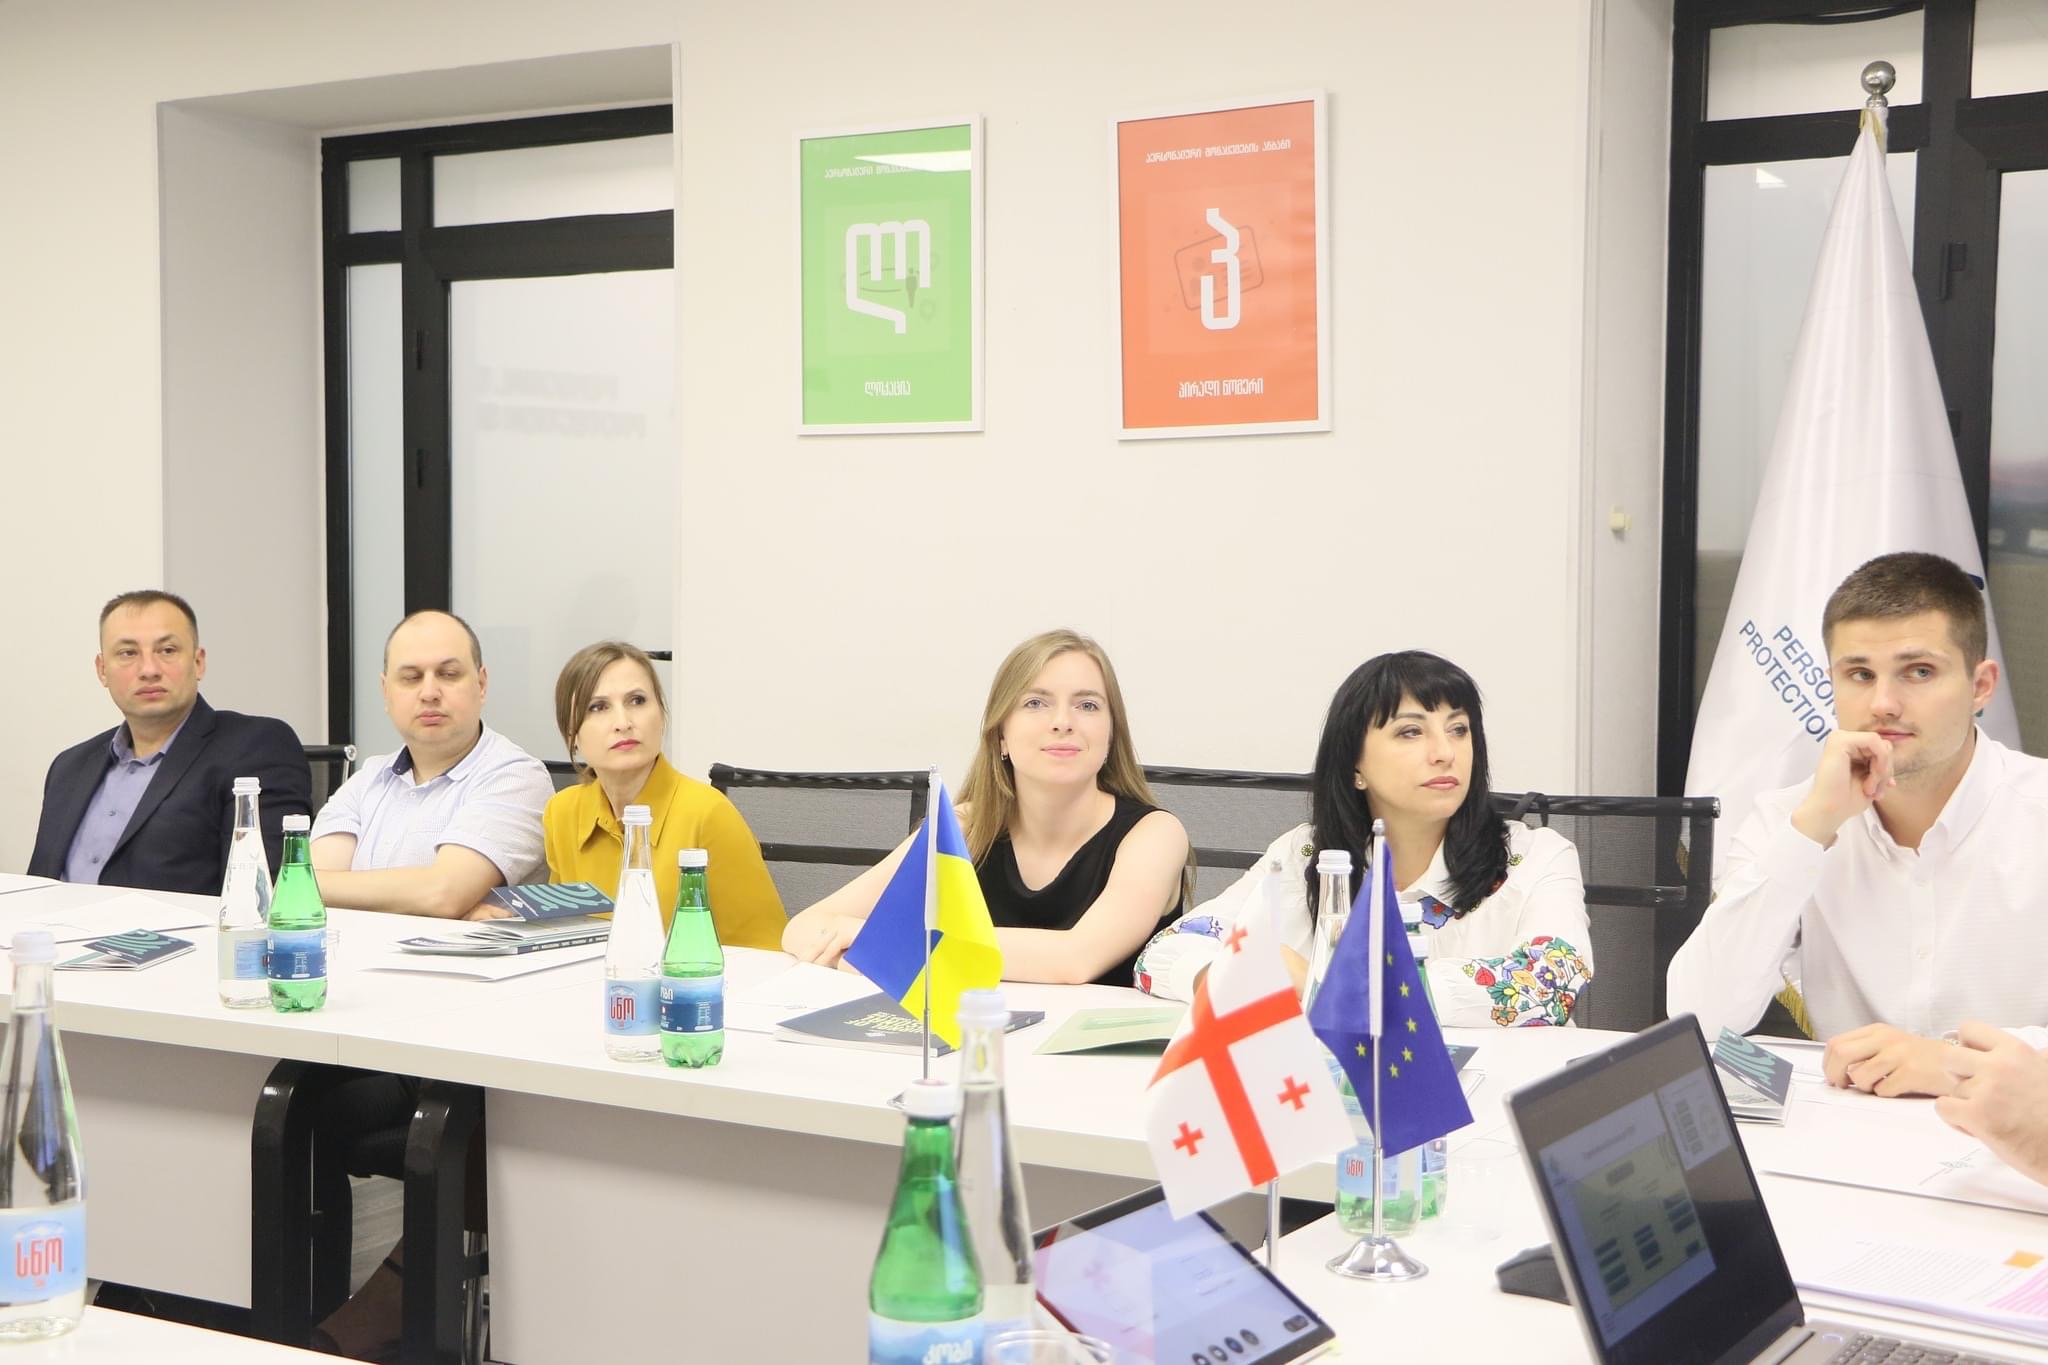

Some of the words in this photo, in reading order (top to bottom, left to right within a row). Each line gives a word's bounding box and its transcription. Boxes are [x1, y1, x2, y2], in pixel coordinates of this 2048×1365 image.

[845, 218, 931, 335] ლ
[1200, 207, 1240, 330] პ
[864, 380, 911, 397] ლოკაცია
[1178, 379, 1220, 398] პირადი
[1222, 376, 1264, 396] ნომერი
[610, 995, 634, 1021] სნო
[15, 1236, 63, 1278] სნო
